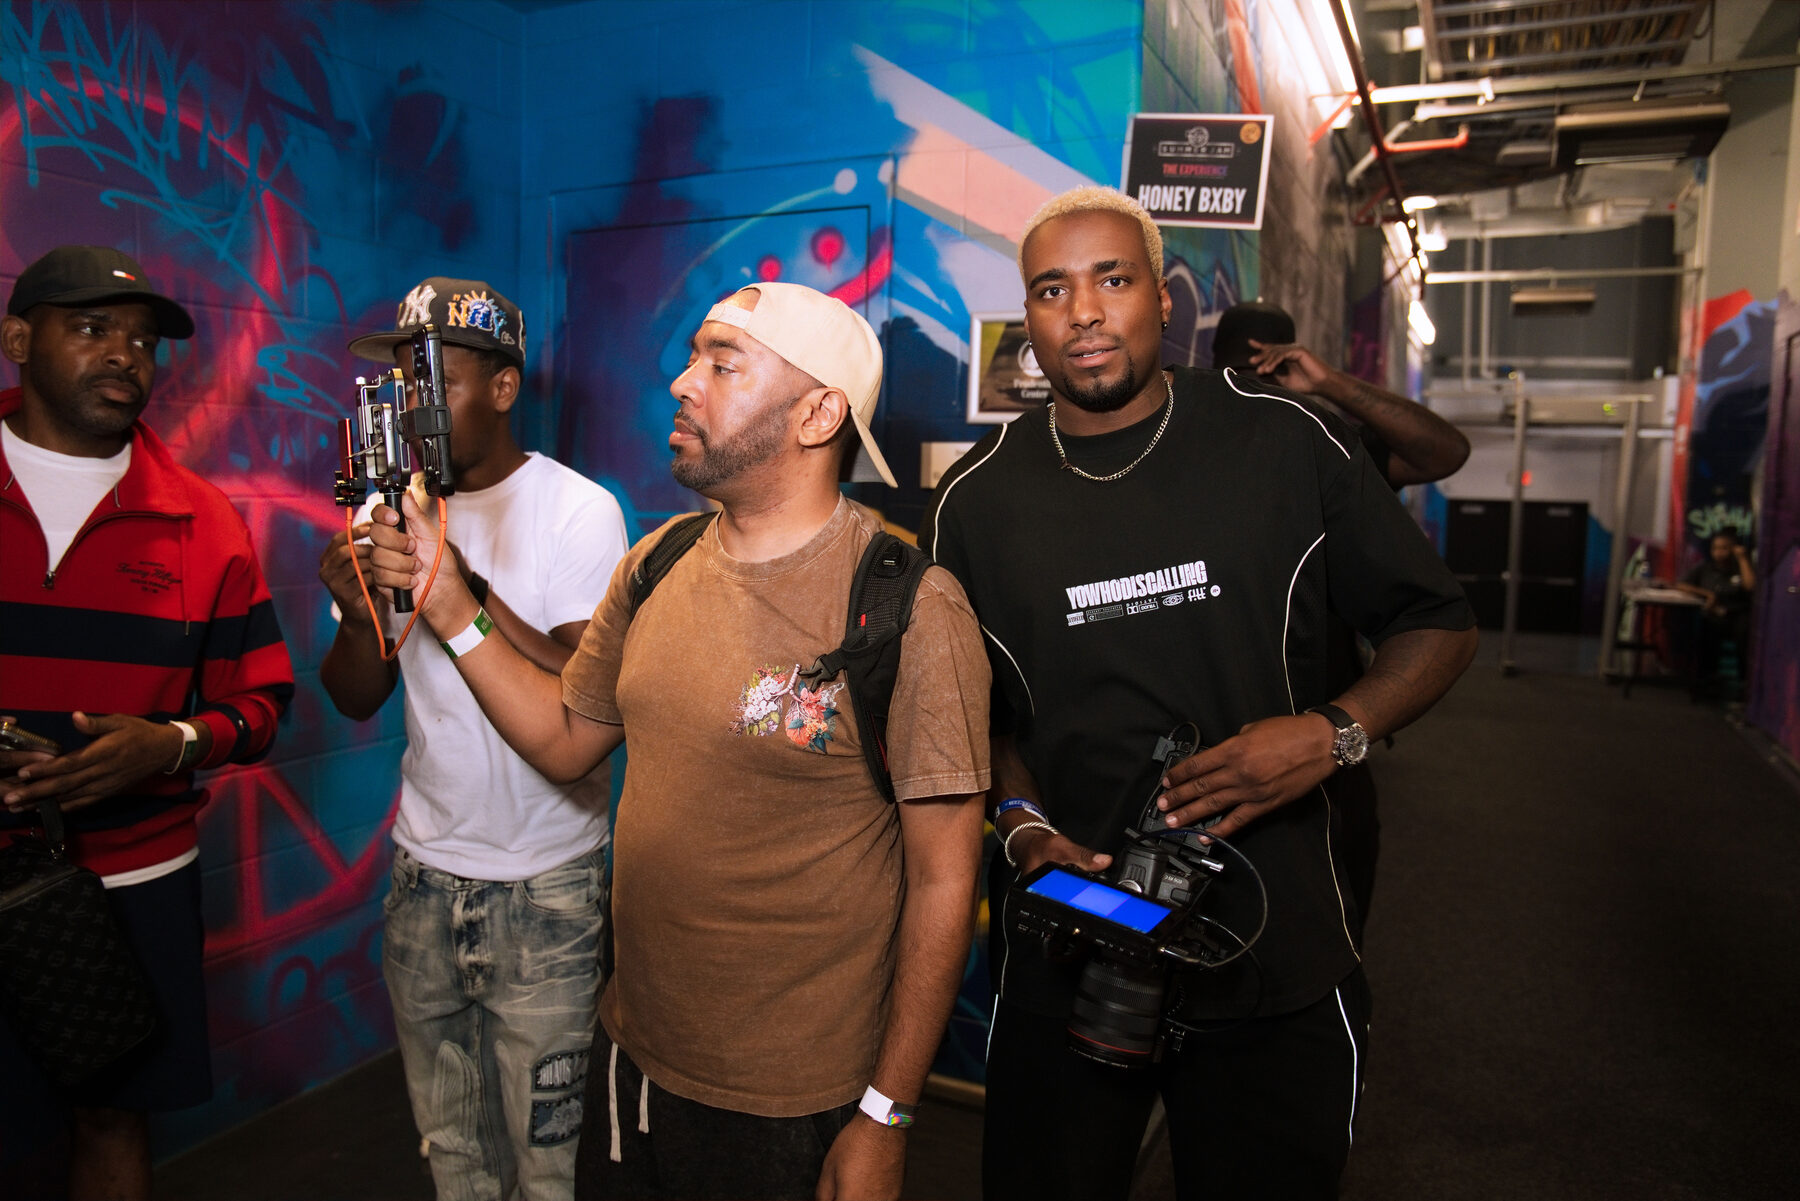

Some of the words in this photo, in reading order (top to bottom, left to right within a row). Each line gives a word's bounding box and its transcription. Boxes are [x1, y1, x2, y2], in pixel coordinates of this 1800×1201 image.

[1162, 163, 1177, 175] THE
[1179, 164, 1228, 176] EXPERIENCE
[1138, 184, 1196, 212] HONEY
[1198, 186, 1247, 214] BXBY
[1065, 560, 1208, 610] YOWHODISCALLING
